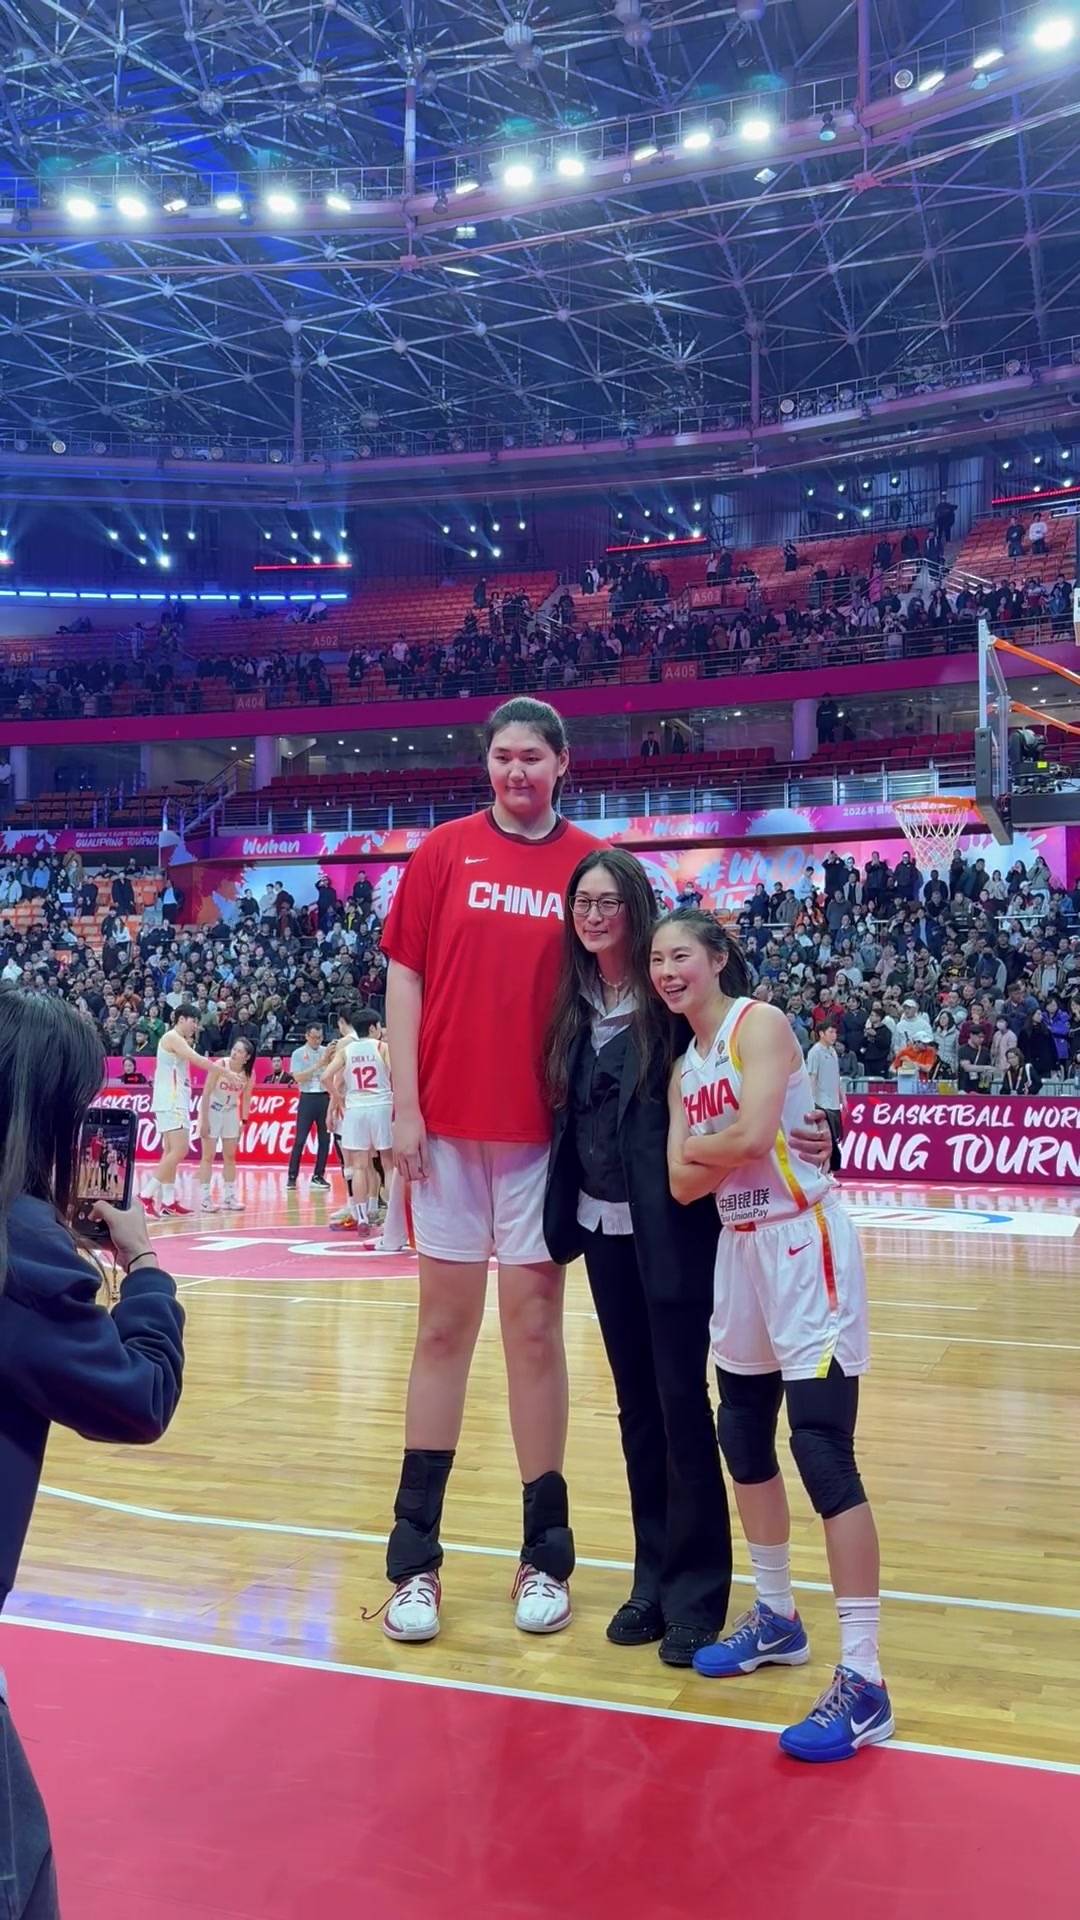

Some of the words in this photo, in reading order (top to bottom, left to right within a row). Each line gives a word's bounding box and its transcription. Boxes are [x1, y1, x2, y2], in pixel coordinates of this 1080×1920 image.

[694, 589, 721, 603] A503
[312, 635, 338, 648] A502
[664, 664, 696, 679] A405
[653, 819, 719, 837] Wuhan
[126, 836, 159, 846] TOURNA
[243, 838, 300, 855] Wuhan
[468, 881, 565, 921] CHINA
[352, 1066, 378, 1089] 12
[88, 1094, 151, 1113] ASKETB
[248, 1096, 285, 1114] CUP
[873, 1103, 1015, 1128] BASKETBALL
[1024, 1106, 1080, 1129] WOR
[840, 1130, 930, 1172] YING
[946, 1133, 1080, 1178] TOURN
[720, 1188, 770, 1212] 中国银联
[731, 1208, 769, 1221] UnionPay
